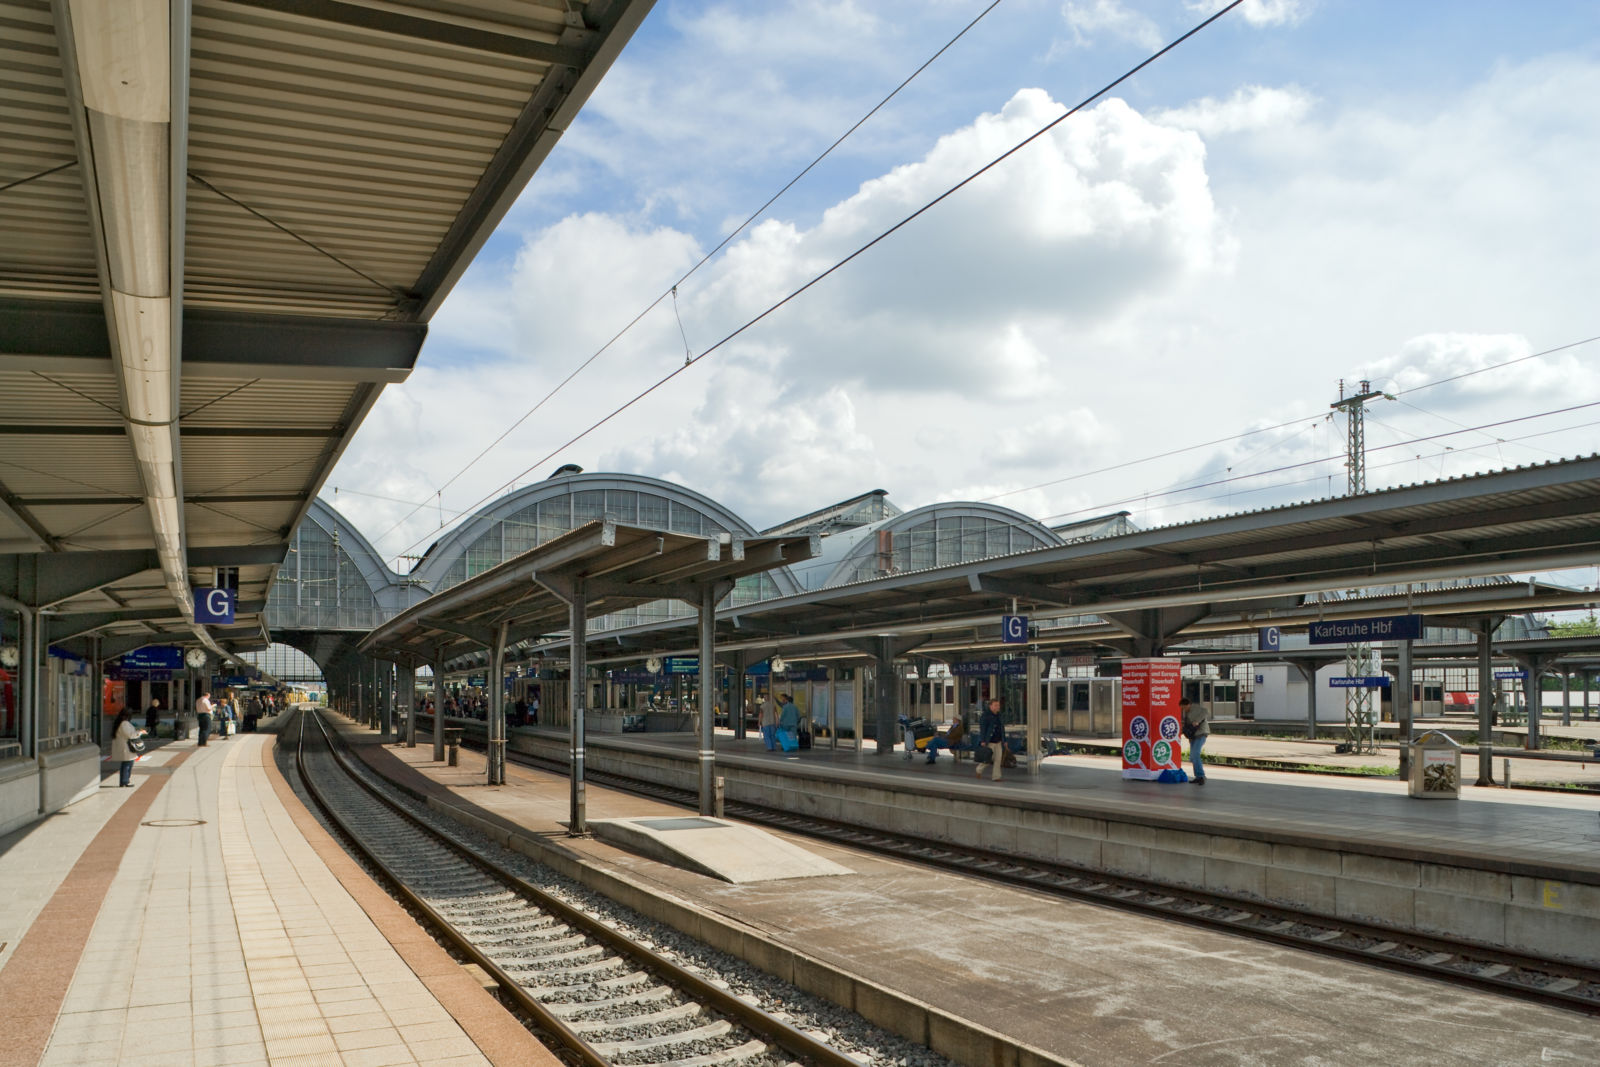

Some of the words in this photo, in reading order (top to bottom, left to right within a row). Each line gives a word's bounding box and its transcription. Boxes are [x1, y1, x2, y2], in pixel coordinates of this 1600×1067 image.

[207, 589, 229, 616] G
[1009, 616, 1022, 638] G
[1267, 627, 1278, 646] G
[1314, 623, 1368, 638] Karlsruhe
[1371, 620, 1392, 634] Hbf
[1134, 722, 1145, 734] 39
[1164, 722, 1175, 734] 39
[1544, 880, 1563, 909] E
